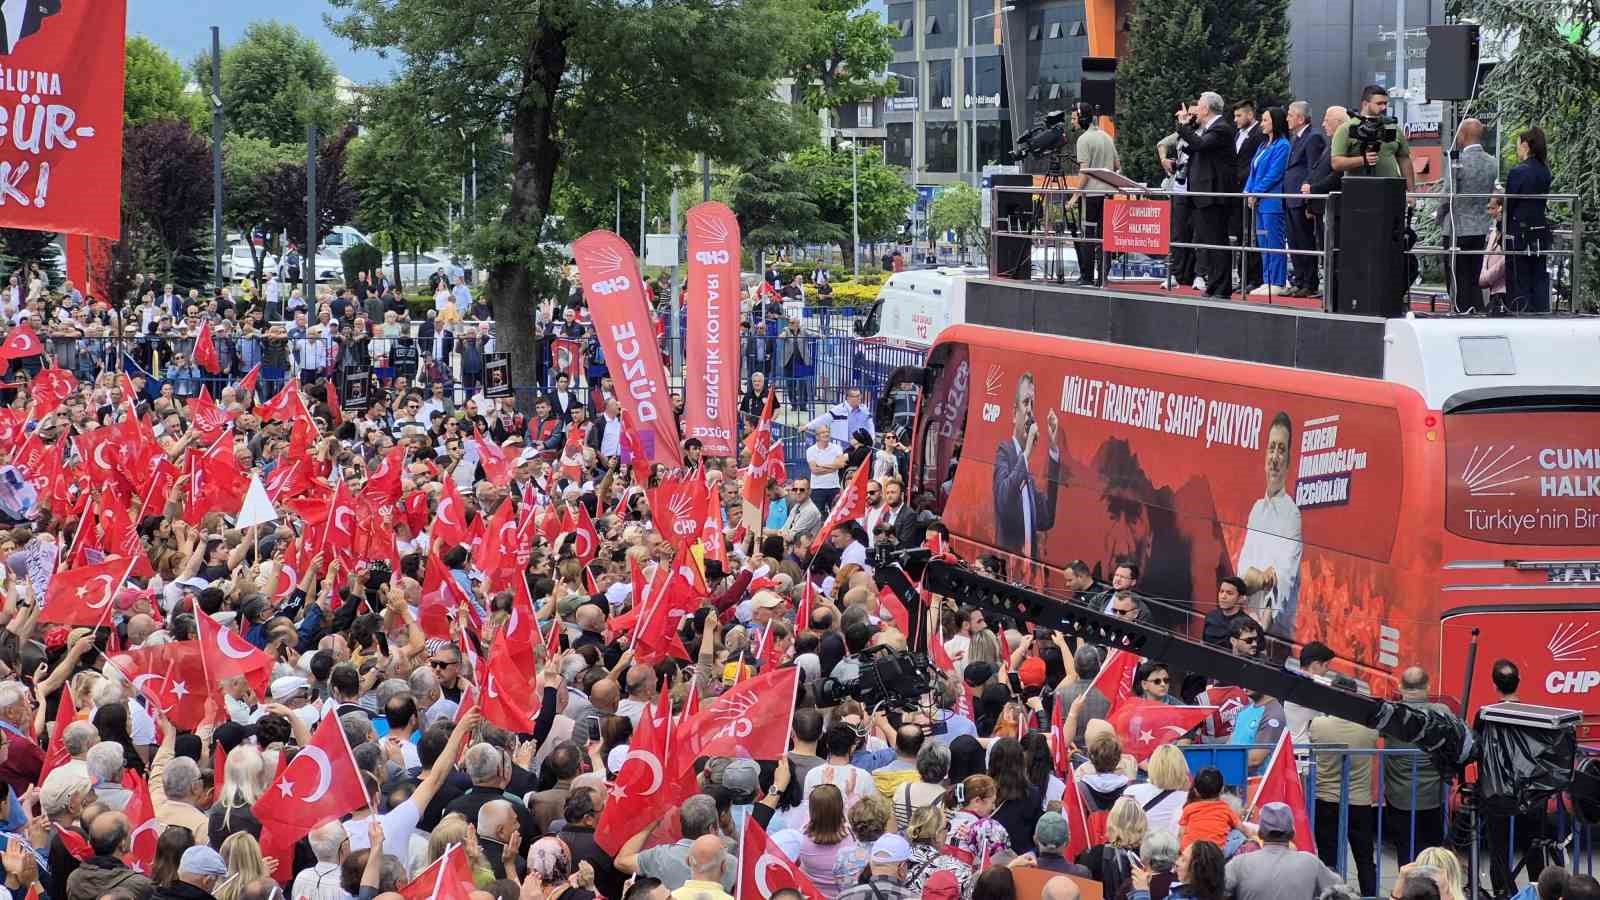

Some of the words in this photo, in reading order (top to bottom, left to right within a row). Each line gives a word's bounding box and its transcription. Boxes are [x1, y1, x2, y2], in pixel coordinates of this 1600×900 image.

[982, 403, 1000, 423] CHP
[1206, 400, 1263, 450] ÇIKIYOR
[673, 519, 697, 535] CHP
[1464, 508, 1569, 535] Türkiye'nin
[1545, 670, 1600, 694] CHP
